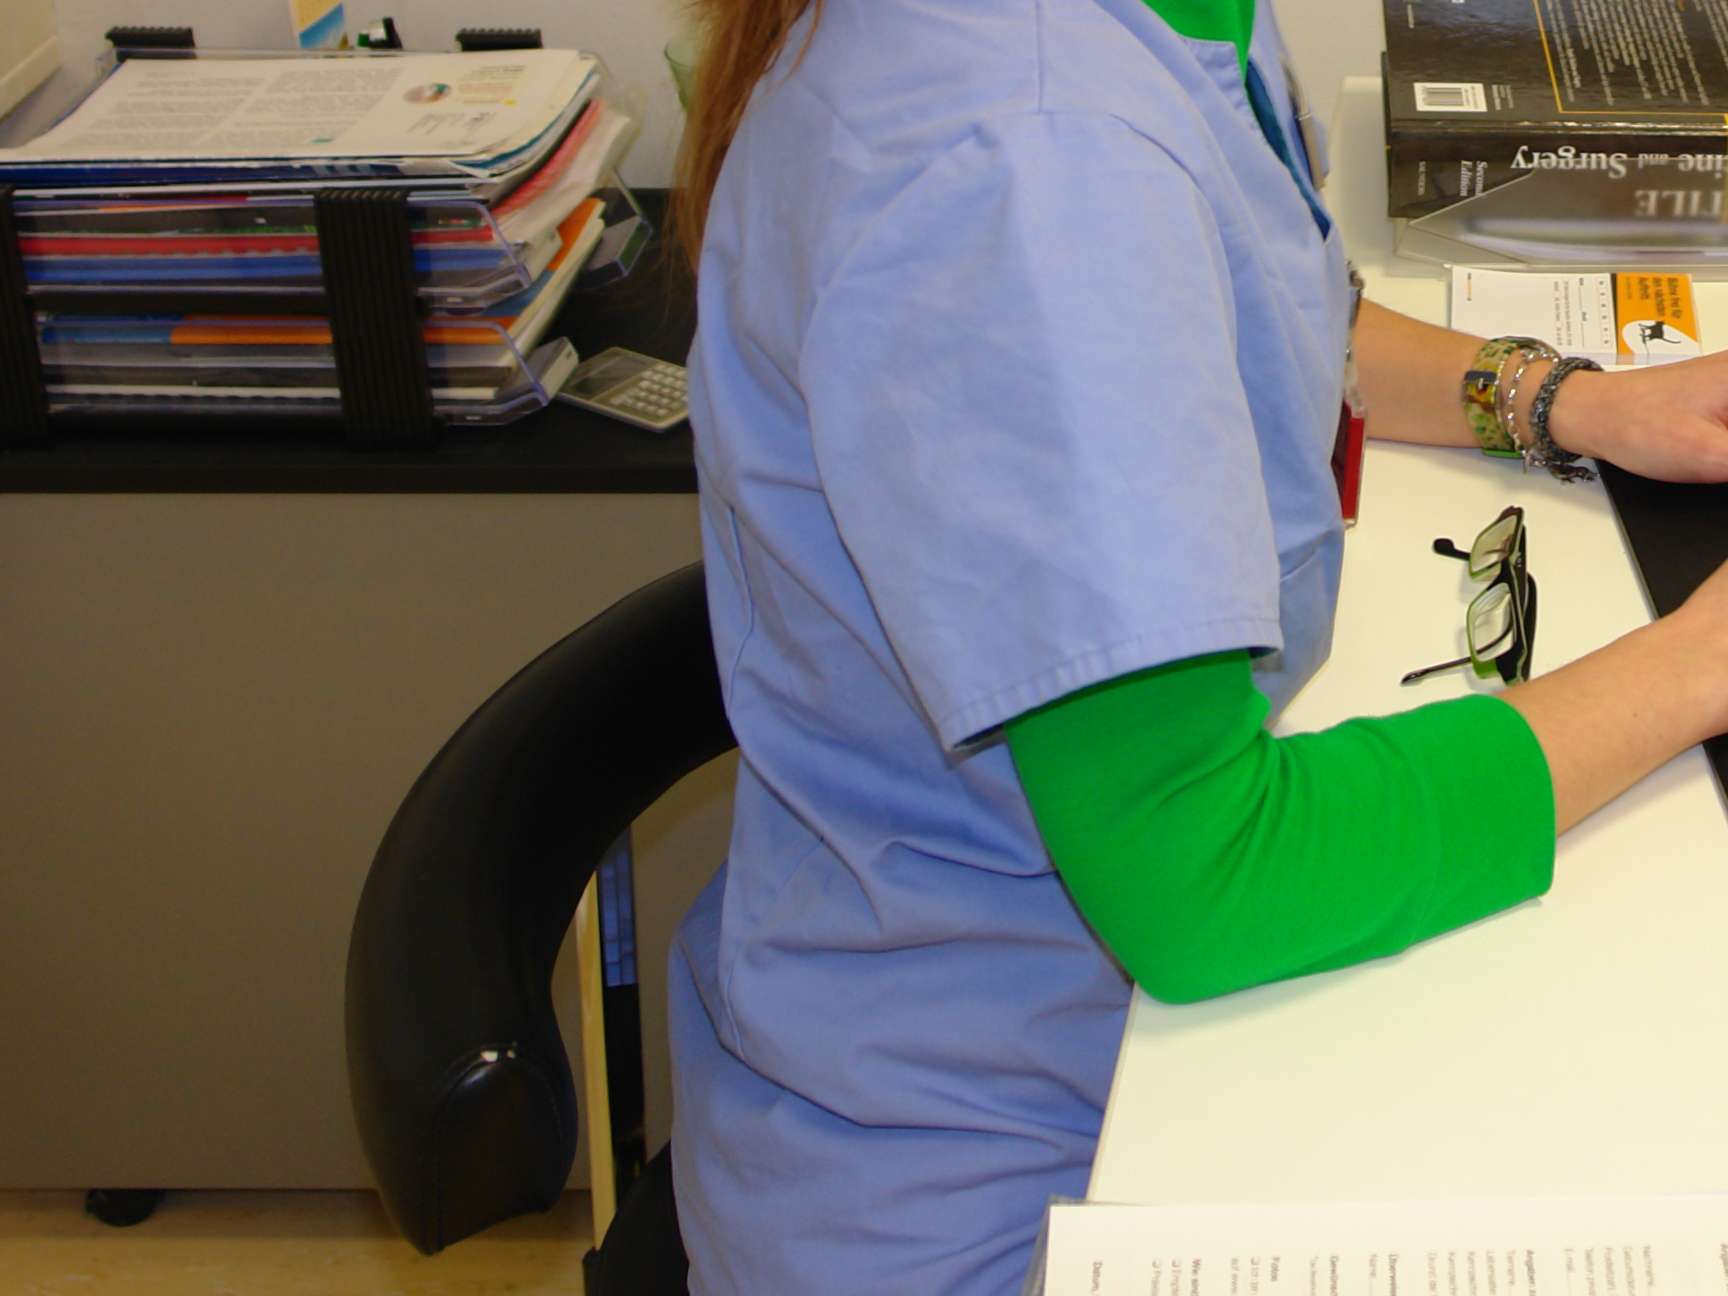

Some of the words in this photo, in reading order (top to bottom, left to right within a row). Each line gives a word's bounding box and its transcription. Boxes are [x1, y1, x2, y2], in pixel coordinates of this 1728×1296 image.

[1459, 159, 1474, 197] Edition
[1511, 145, 1627, 180] Surgery
[1638, 153, 1669, 171] and
